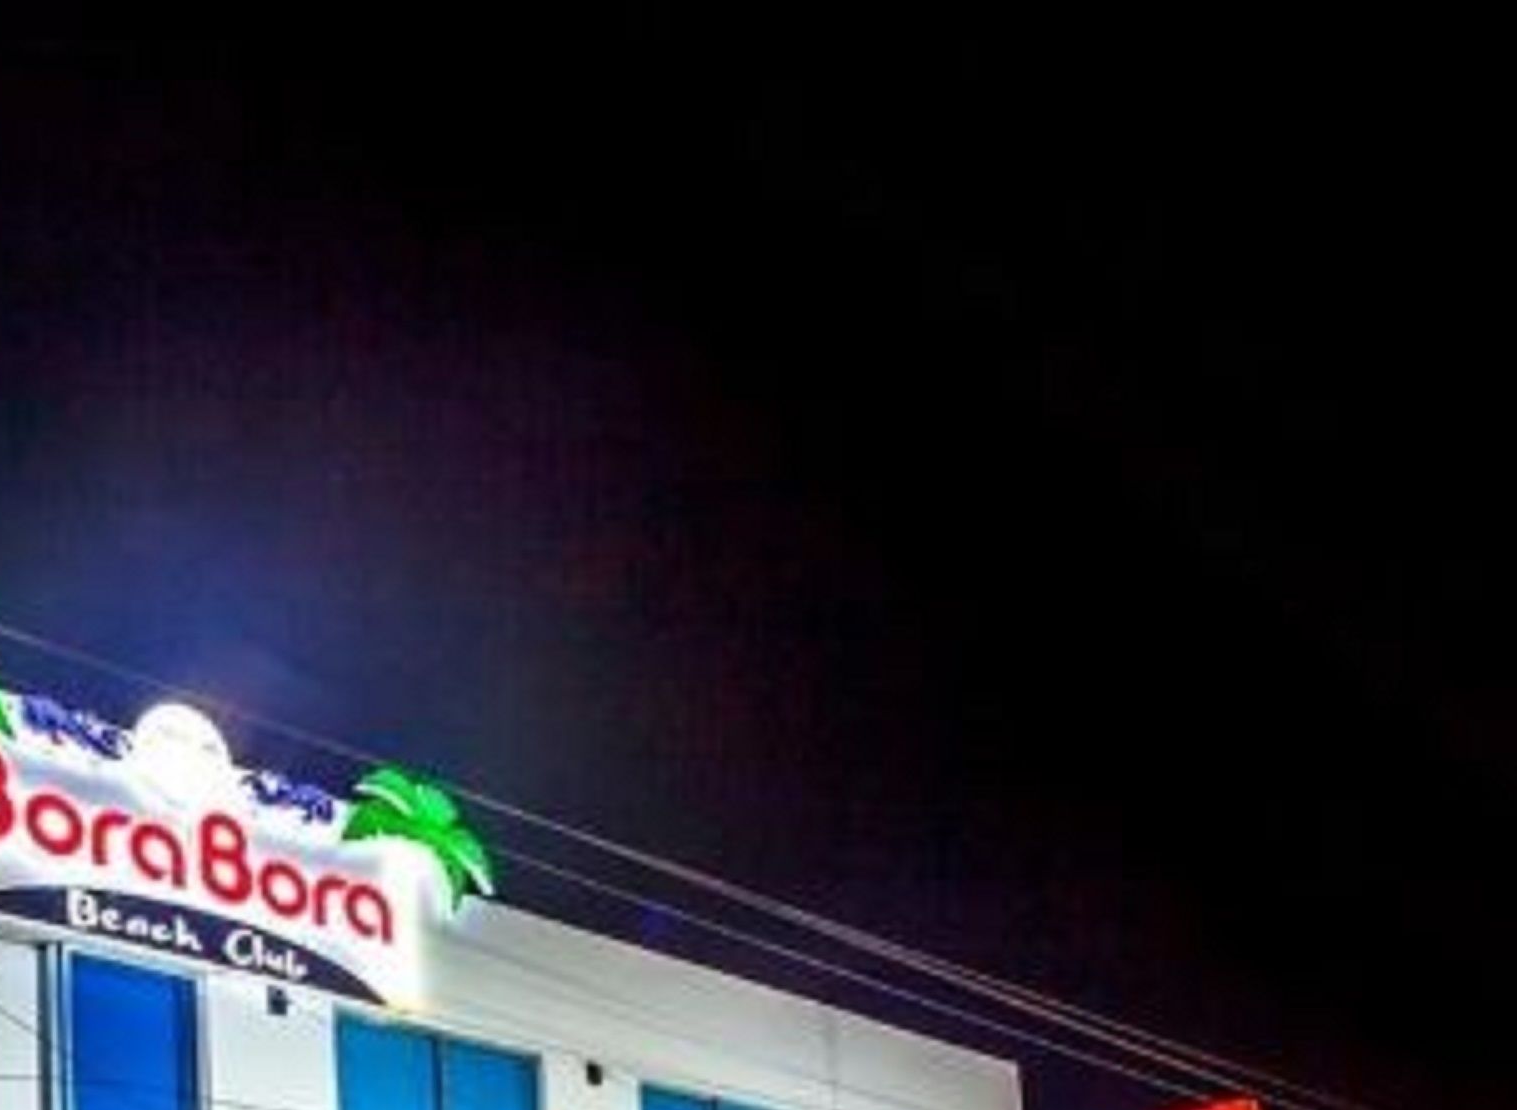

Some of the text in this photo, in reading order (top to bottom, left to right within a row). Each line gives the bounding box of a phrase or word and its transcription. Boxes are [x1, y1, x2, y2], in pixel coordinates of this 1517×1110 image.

[198, 812, 393, 943] Bora
[66, 890, 308, 980] Beach Club
